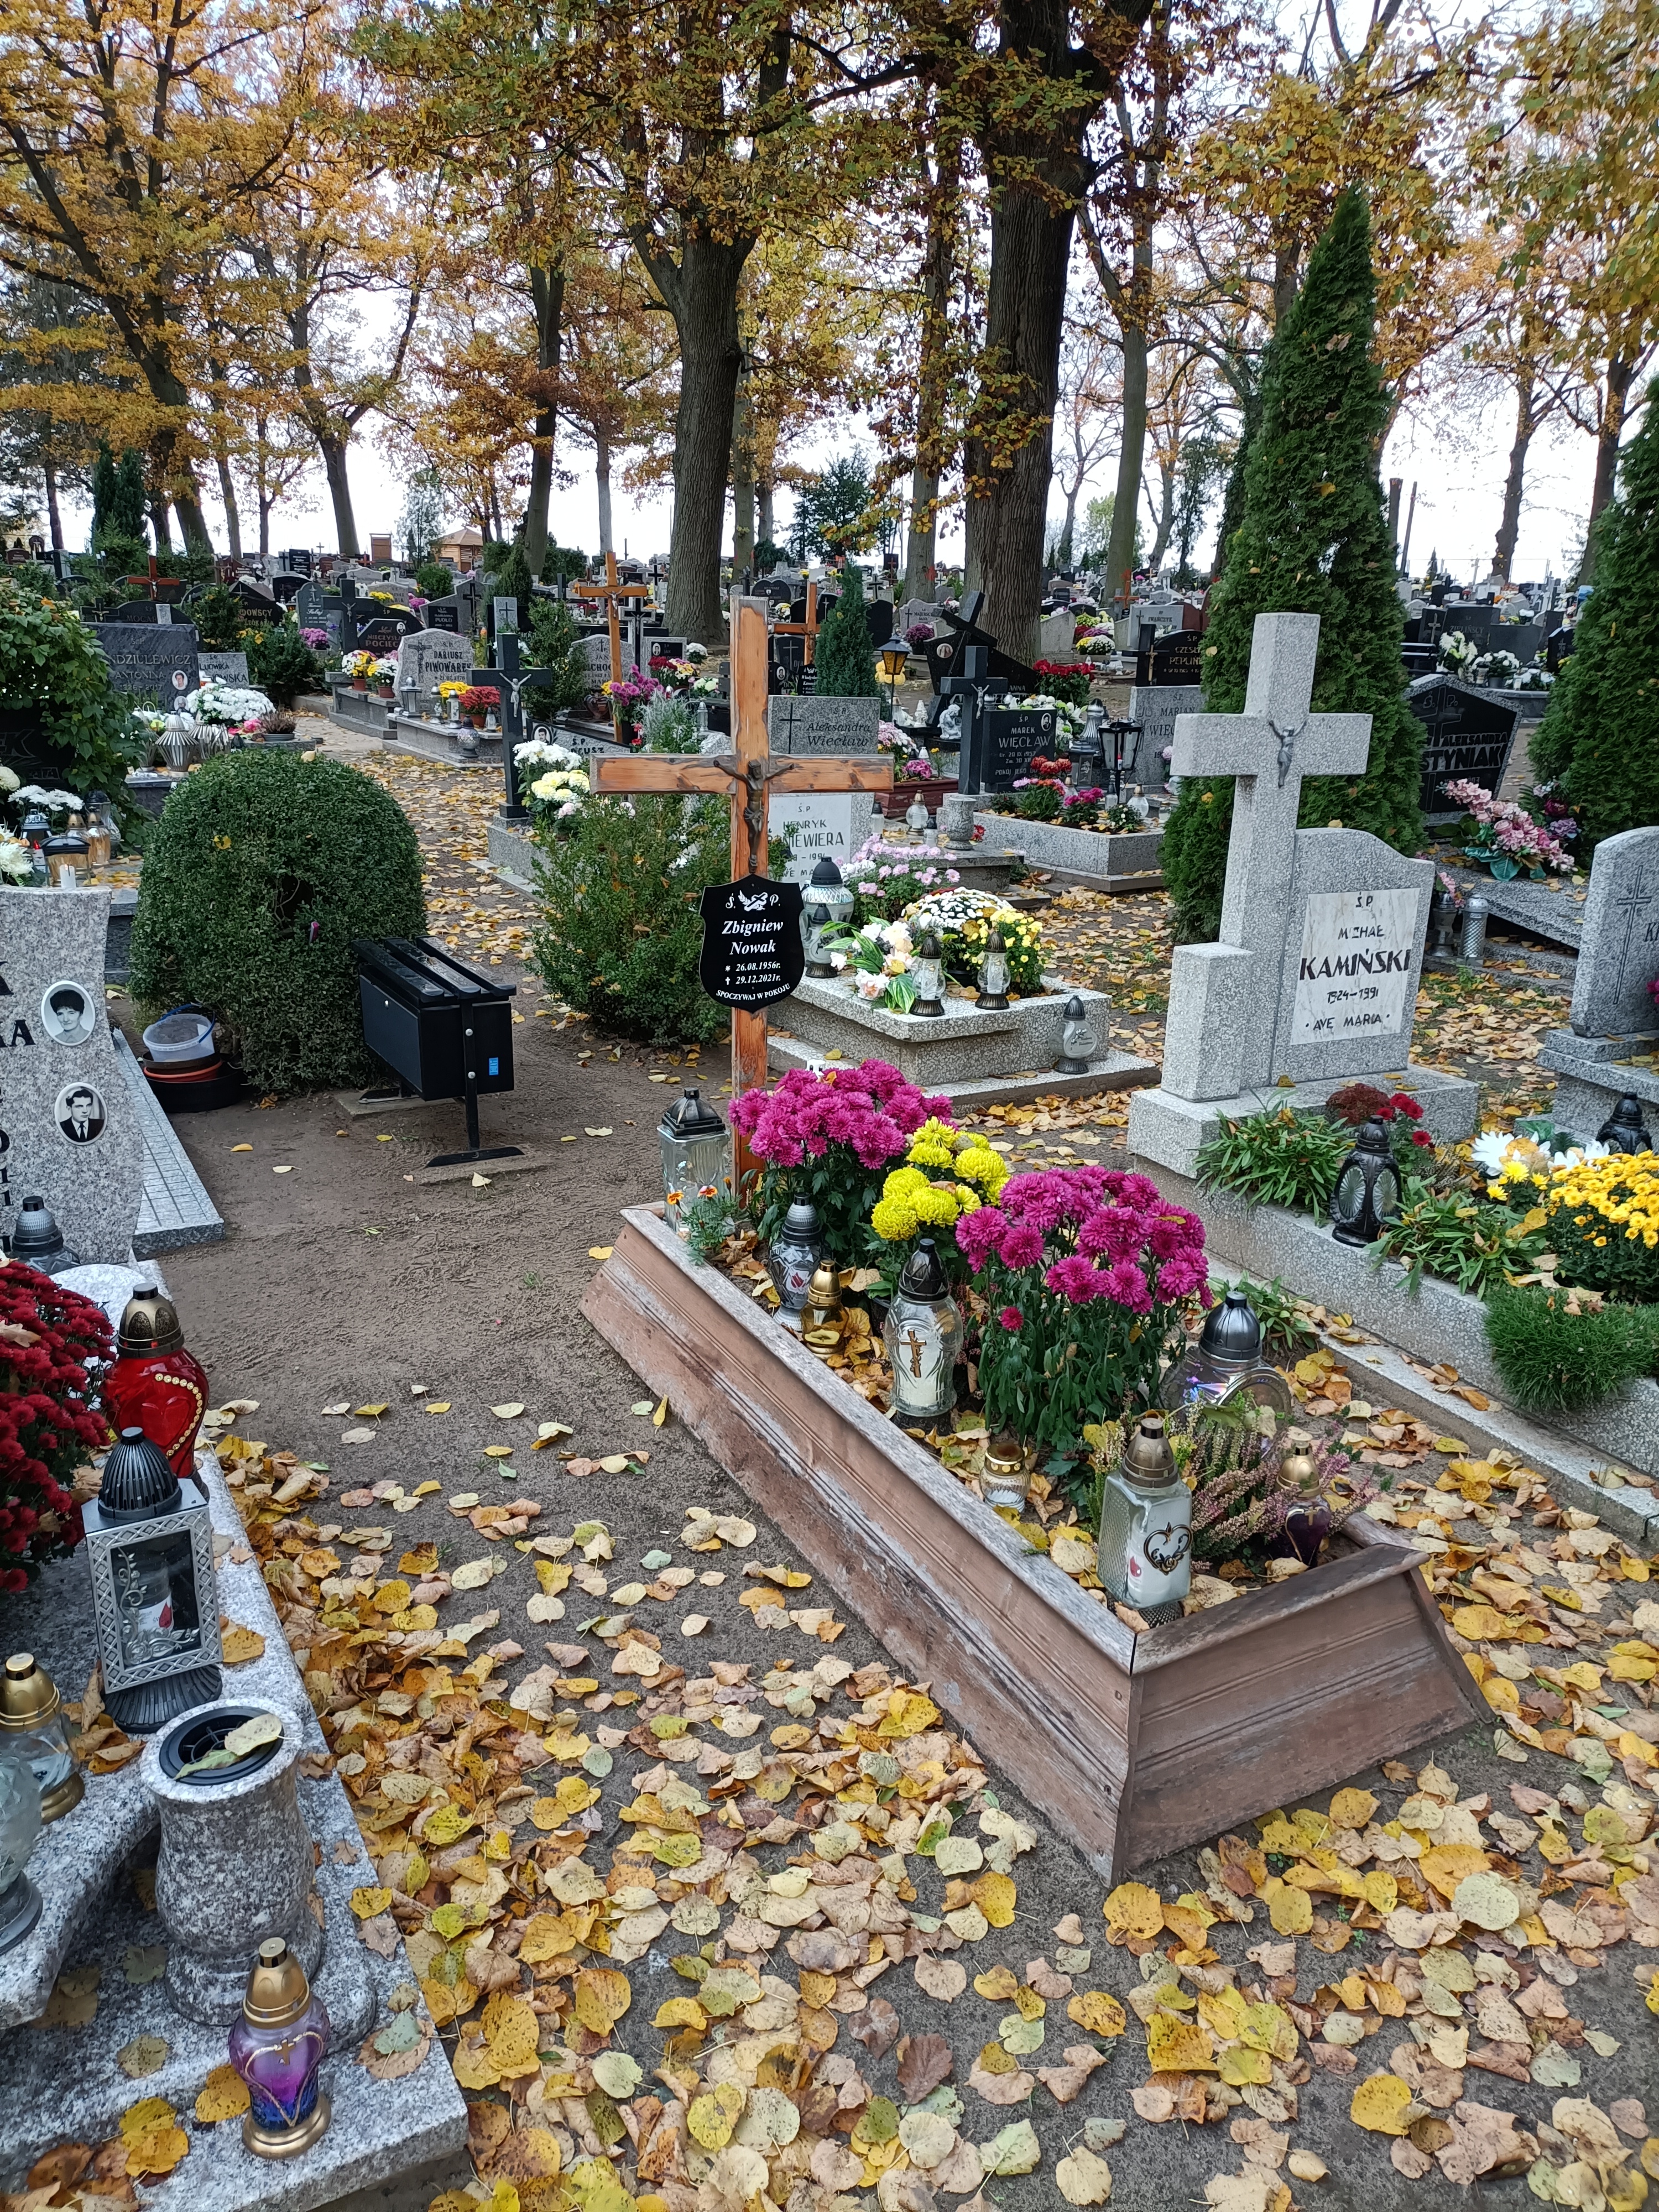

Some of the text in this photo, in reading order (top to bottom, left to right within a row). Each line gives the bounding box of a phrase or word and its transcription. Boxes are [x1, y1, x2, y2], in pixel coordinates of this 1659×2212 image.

[434, 651, 463, 659] DARIUSZ
[115, 671, 165, 679] ANTONINA
[1160, 707, 1196, 716] MARIAN
[806, 722, 870, 732] Aleksandra
[1011, 726, 1035, 734] MAREK
[998, 735, 1051, 749] WIĘCŁAW
[1440, 732, 1508, 747] ALEKSANDRA
[995, 767, 1011, 775] POKÓJ
[783, 819, 827, 830] HENRYK
[721, 919, 784, 937] Zbigniew
[729, 939, 776, 955] Nowak
[735, 961, 781, 972] 26.08.1956r.
[1299, 948, 1412, 980] KAMIŃSKI
[735, 973, 781, 984] 29.12.2021r.
[716, 989, 756, 1000] SPOCZYWAJ
[764, 983, 791, 998] POKOJU
[1327, 987, 1379, 1004] 1924-1991
[1312, 1013, 1382, 1031] AVE MARIA
